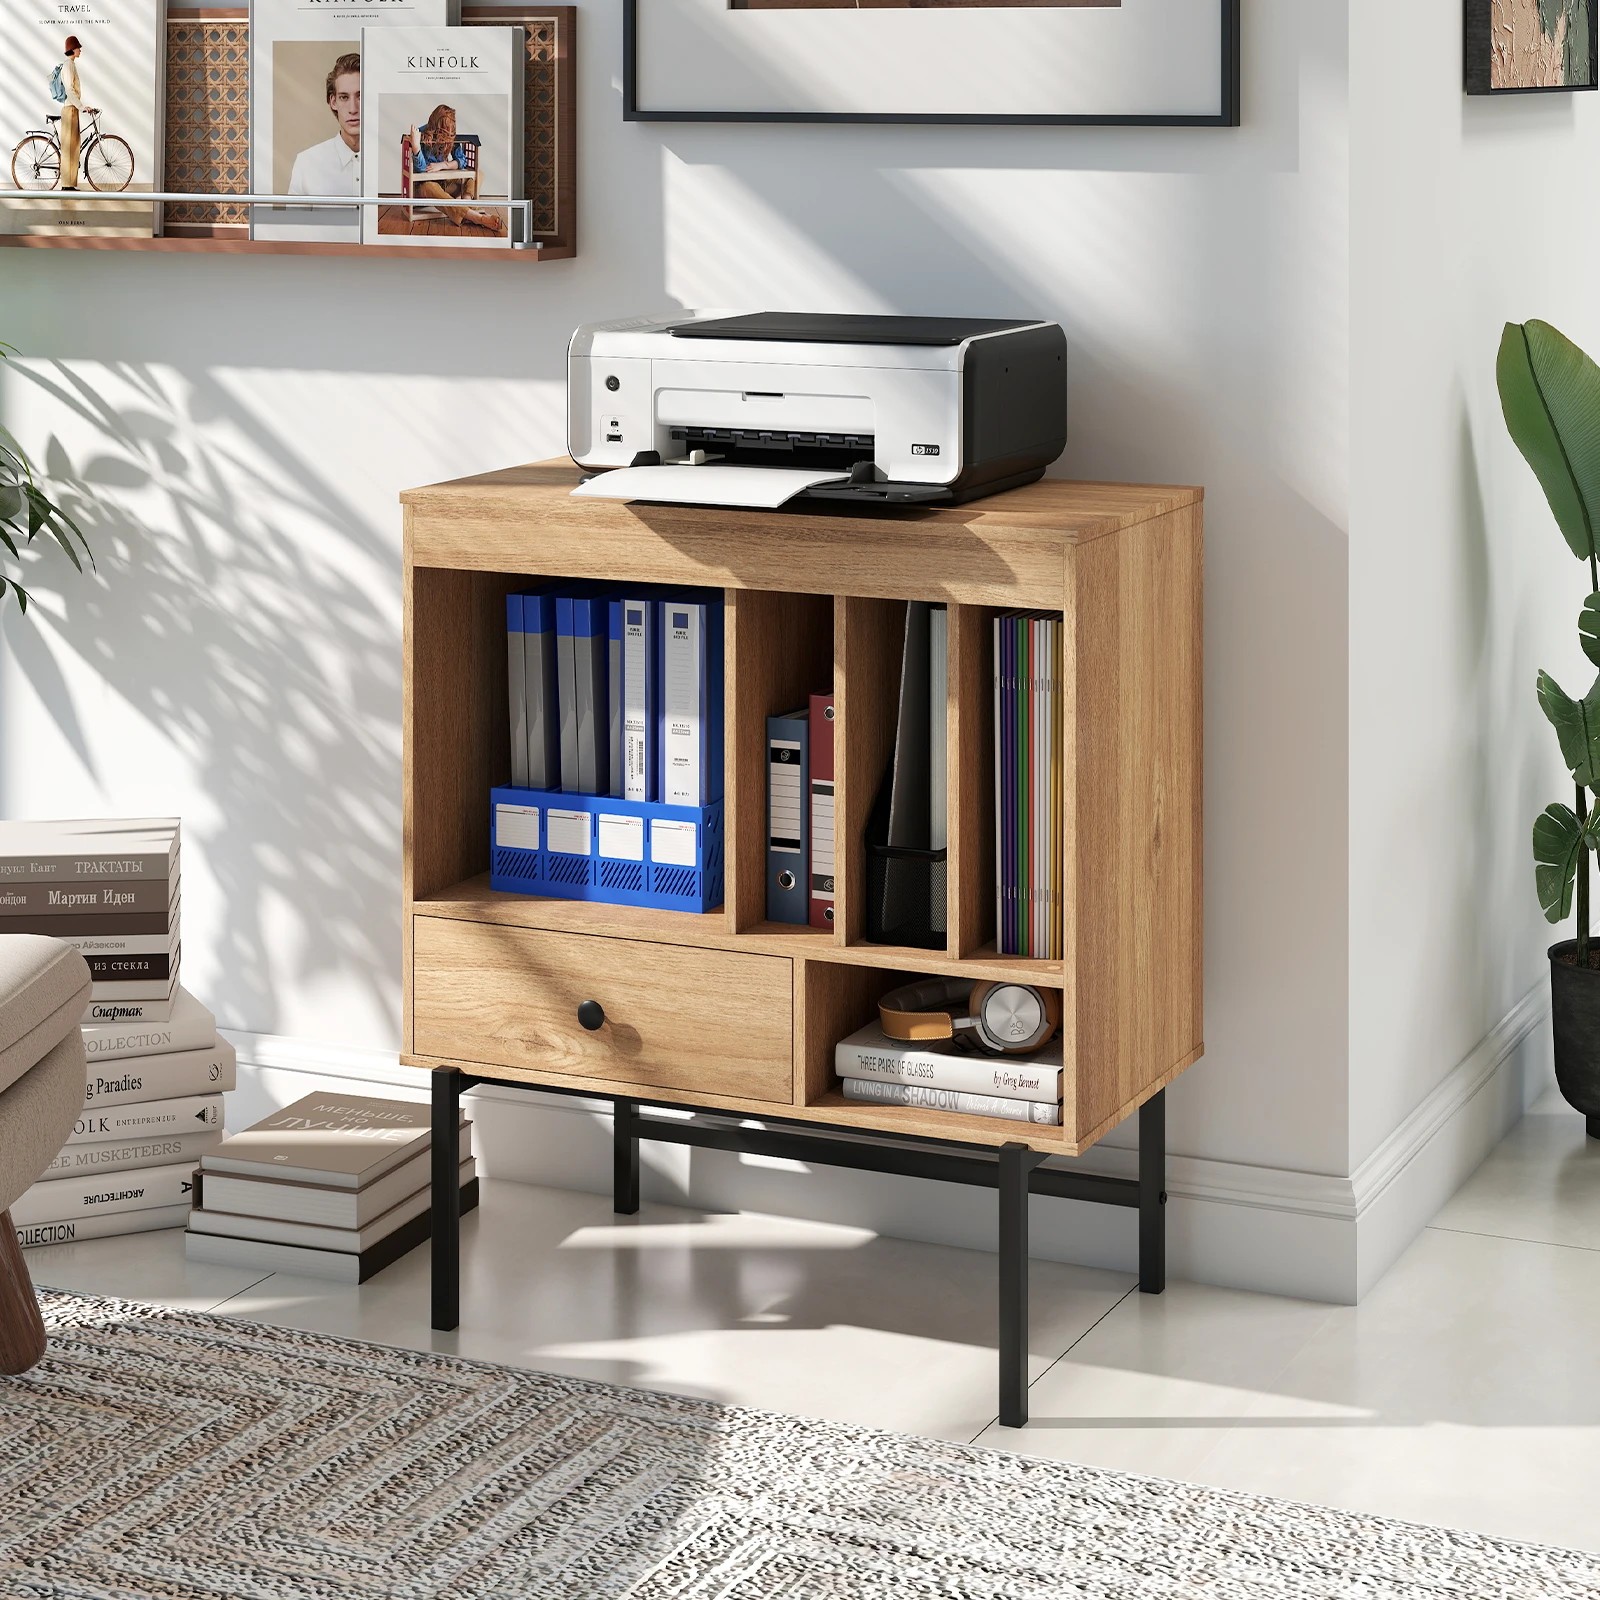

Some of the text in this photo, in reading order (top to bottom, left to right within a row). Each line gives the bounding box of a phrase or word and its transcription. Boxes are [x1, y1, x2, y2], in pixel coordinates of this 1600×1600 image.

[58, 5, 91, 13] TRAVEL
[407, 56, 479, 69] KINFOLK
[30, 862, 57, 873] Кант
[74, 860, 144, 874] ТРАКТАТЫ
[48, 890, 98, 908] Мартин
[103, 888, 136, 906] Иден
[94, 961, 150, 971] из стекла
[92, 1005, 143, 1021] Спартак
[858, 1054, 935, 1079] THREE PAIRS OF GLASSES
[96, 1073, 143, 1095] Paradies
[853, 1081, 960, 1110] LIVING IN A SHADOW
[76, 1141, 182, 1166] MUSKETEERS
[83, 1188, 145, 1205] ARCHITECTURE
